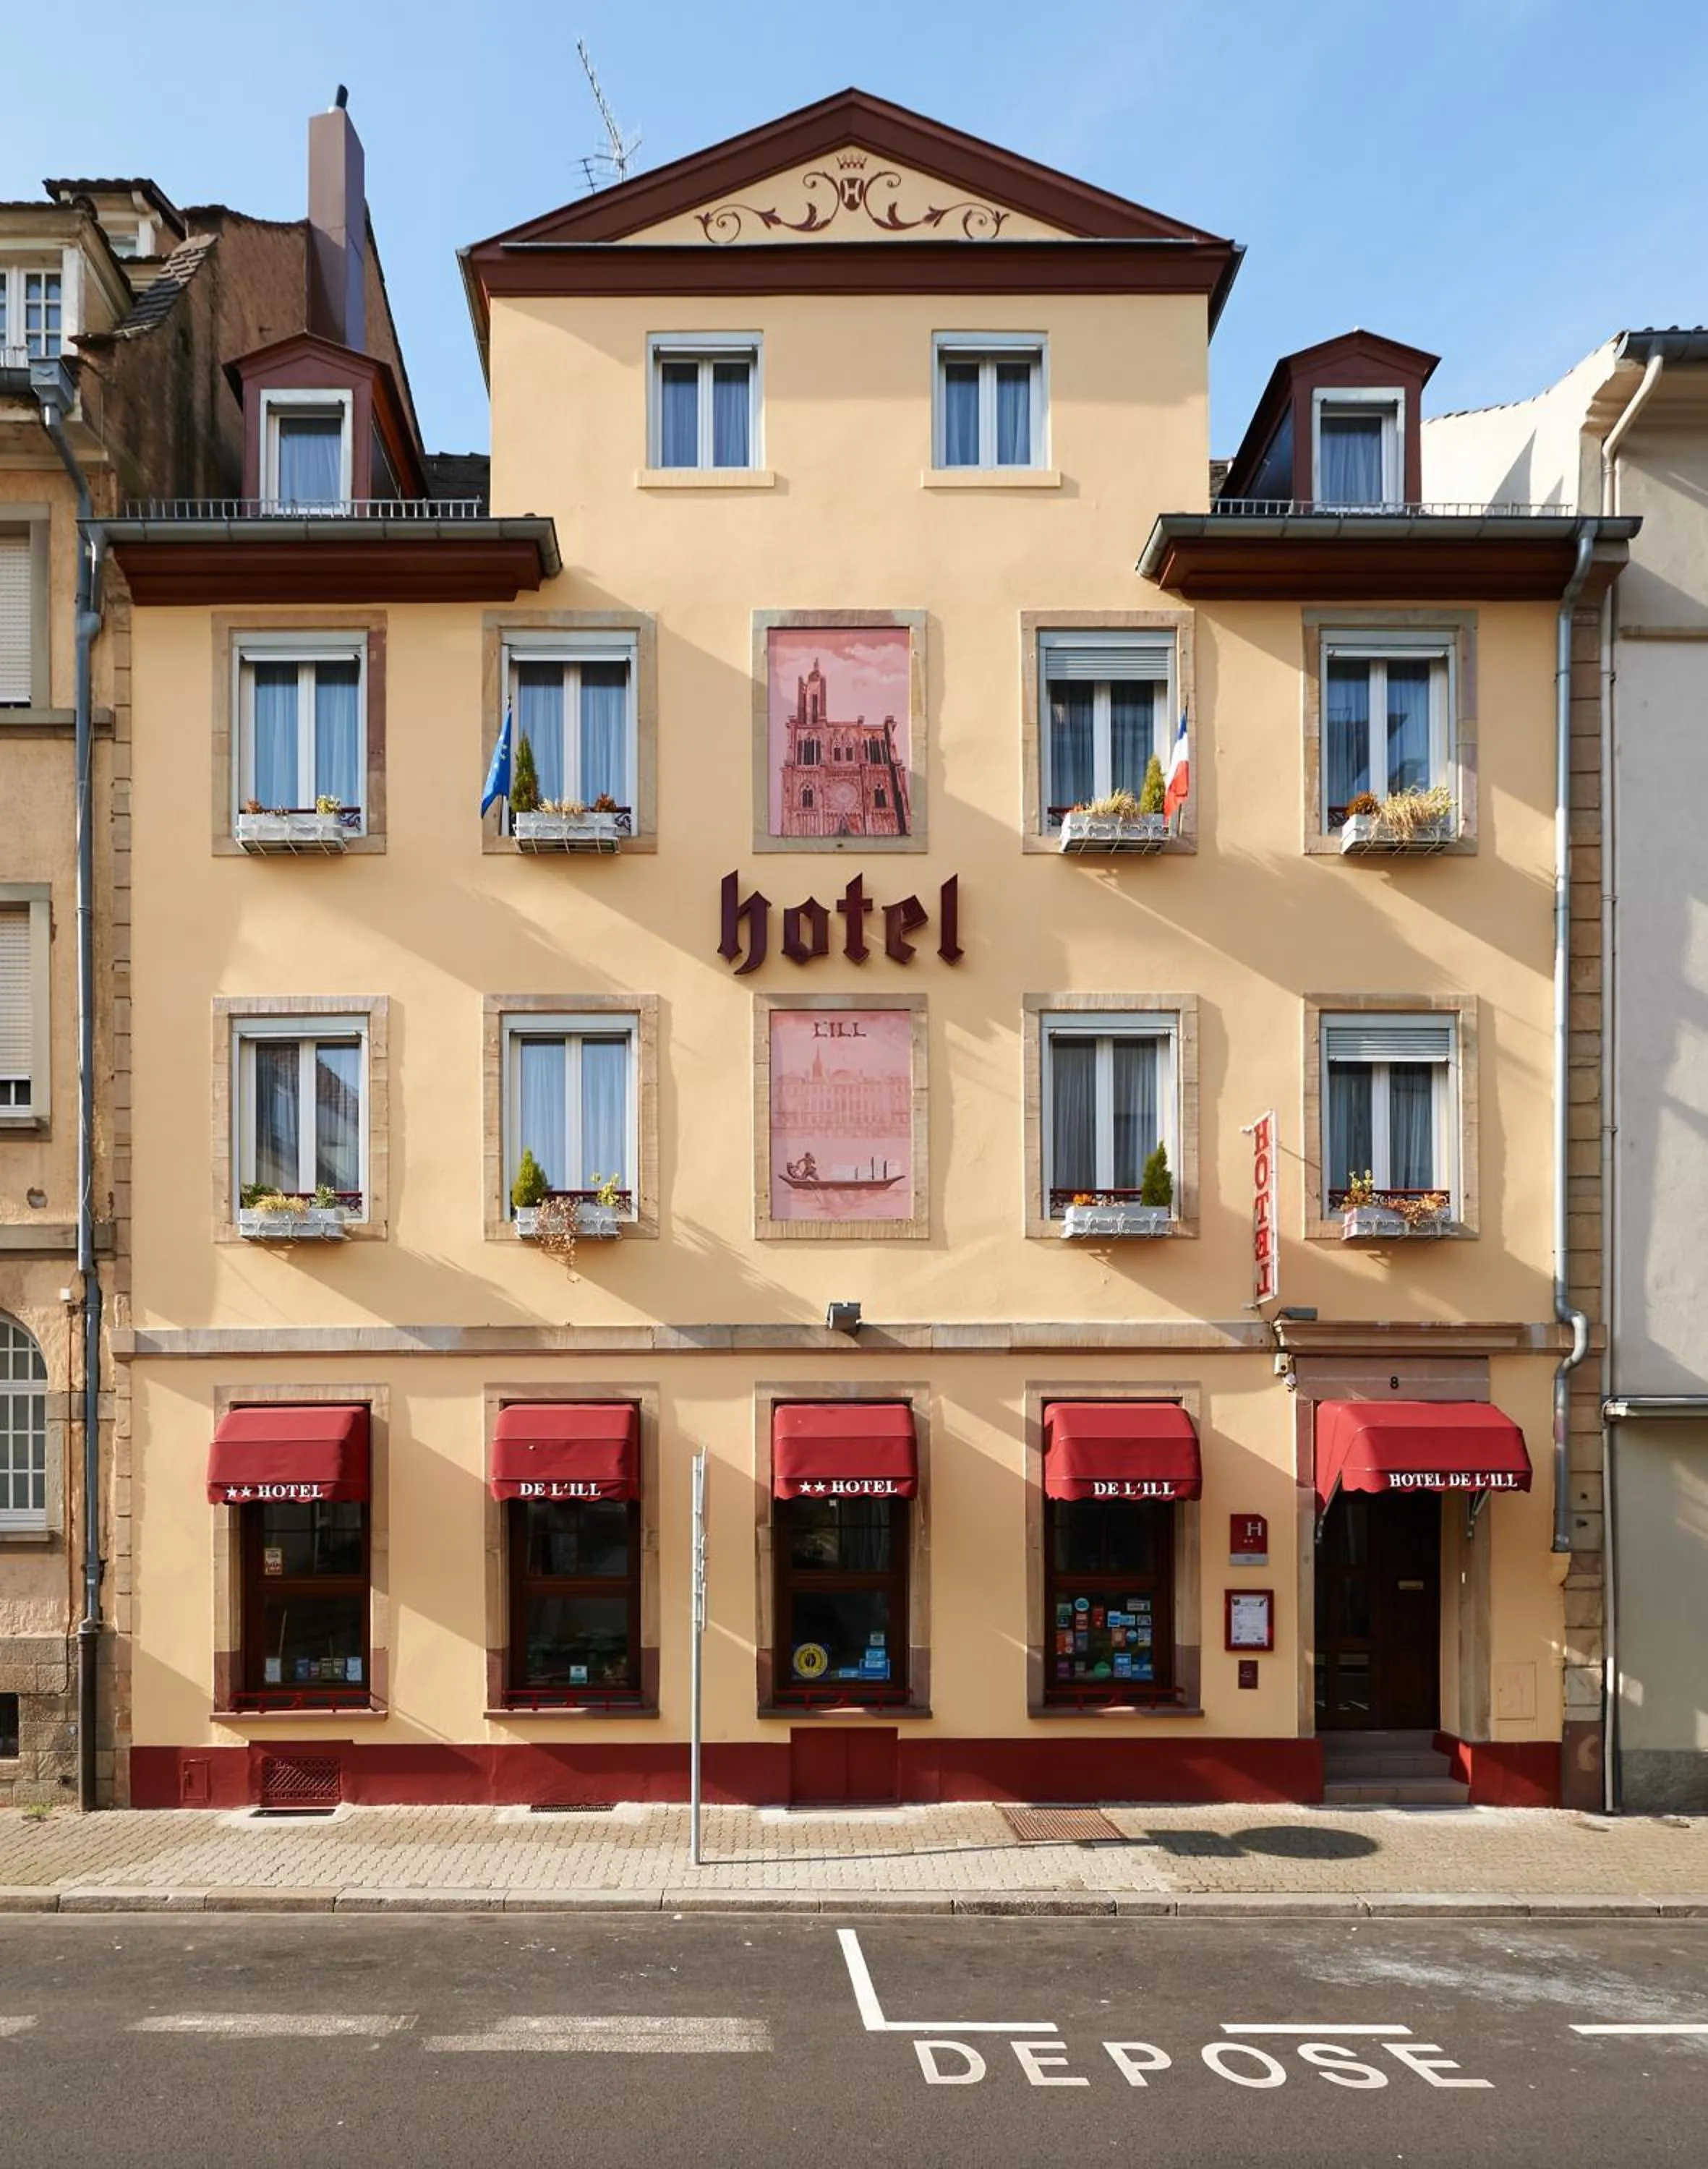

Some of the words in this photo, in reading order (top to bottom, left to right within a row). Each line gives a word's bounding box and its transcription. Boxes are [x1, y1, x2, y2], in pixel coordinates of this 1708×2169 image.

[717, 870, 965, 975] hotel
[1390, 1376, 1399, 1390] 8
[831, 1480, 897, 1493] HOTEL
[1389, 1473, 1446, 1487] HOTEL
[1449, 1473, 1472, 1486] DE
[1476, 1473, 1518, 1487] L'ILL
[257, 1484, 323, 1498] HOTEL
[520, 1483, 545, 1496] DE
[551, 1483, 602, 1496] L'ILL
[1093, 1481, 1119, 1495] DE
[1124, 1481, 1175, 1495] L'ILL
[1247, 1522, 1262, 1536] H
[913, 2040, 1496, 2088] DEPOSE
